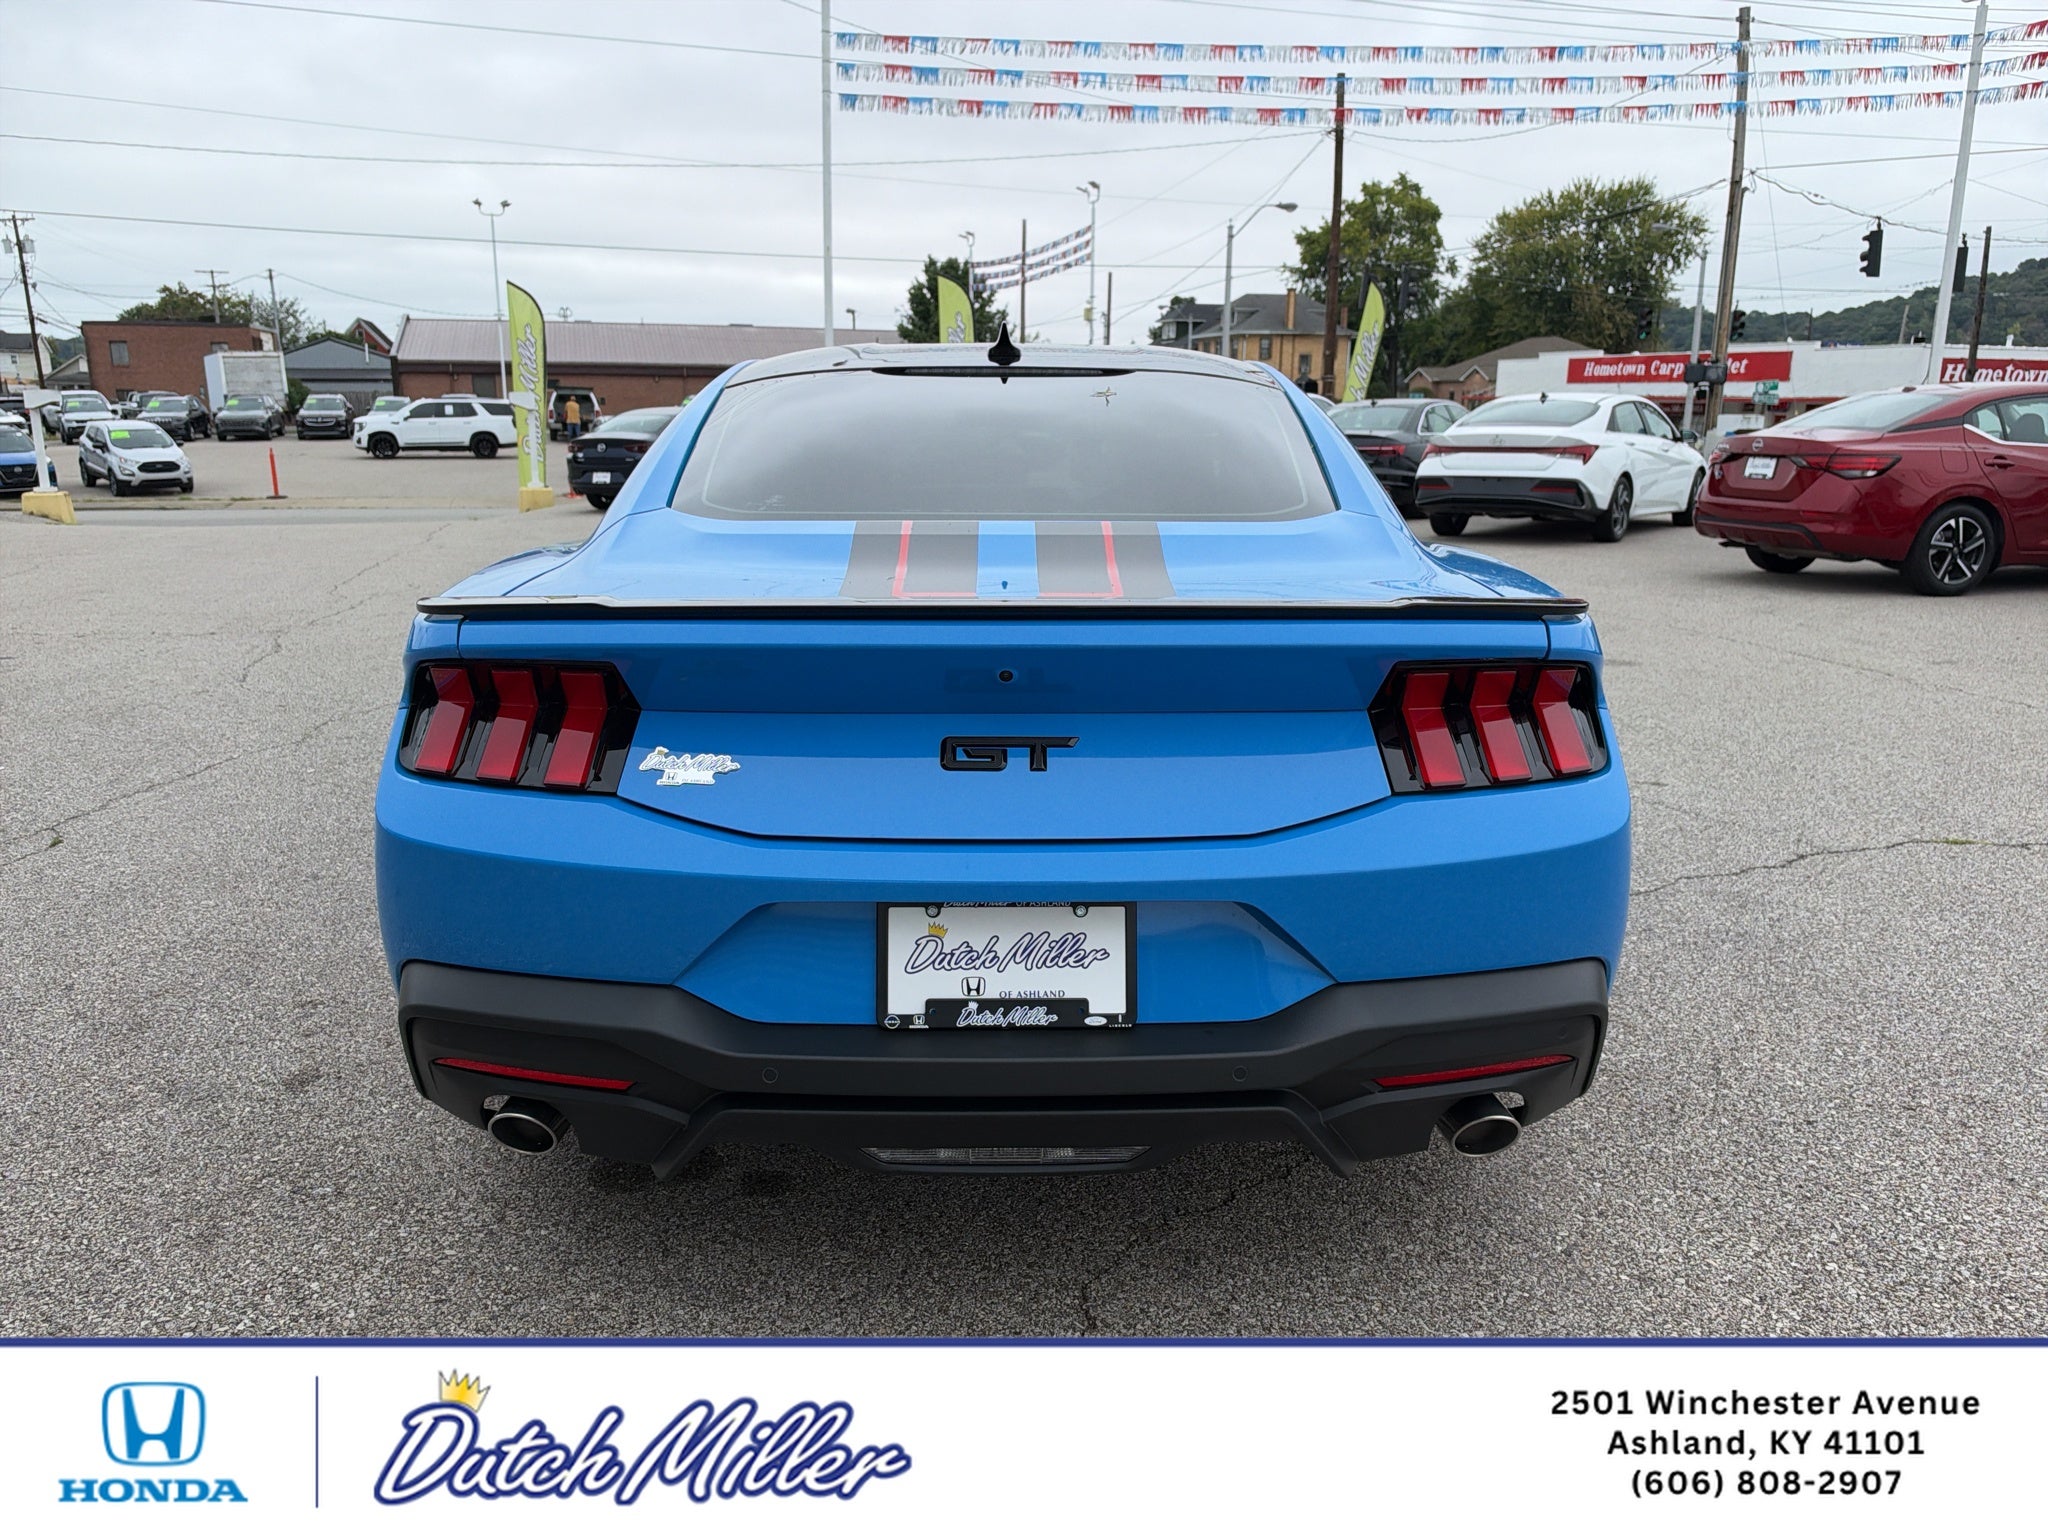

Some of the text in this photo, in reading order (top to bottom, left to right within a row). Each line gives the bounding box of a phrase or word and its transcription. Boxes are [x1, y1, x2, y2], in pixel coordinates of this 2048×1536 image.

[517, 323, 541, 401] Miller
[1583, 360, 1646, 377] Hometown
[1650, 359, 1686, 378] Carp
[940, 736, 1080, 772] GT
[904, 931, 1110, 974] Dutch Miller
[999, 989, 1066, 999] OF ASHLAND
[956, 1005, 1058, 1027] Dutch Miller
